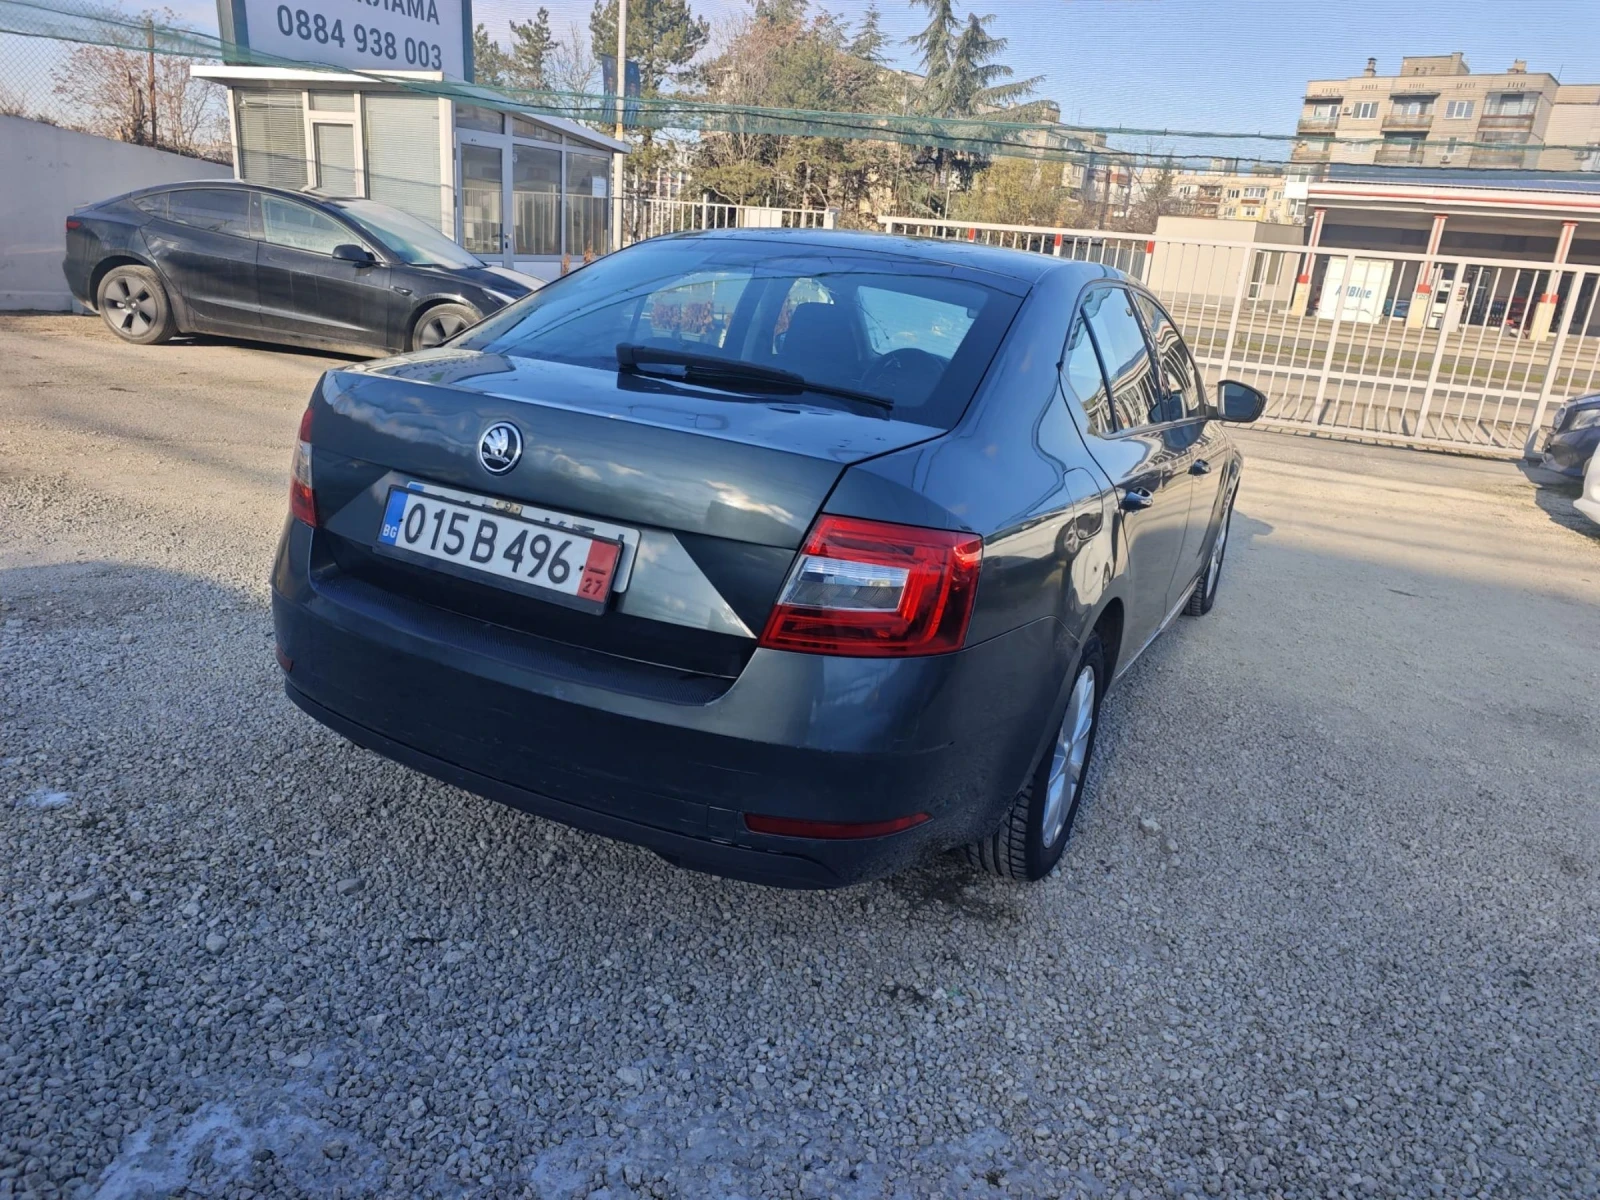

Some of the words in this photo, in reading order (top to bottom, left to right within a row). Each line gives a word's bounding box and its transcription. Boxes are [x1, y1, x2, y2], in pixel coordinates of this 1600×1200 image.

[277, 5, 345, 48] 0884
[354, 24, 397, 60] 938
[404, 37, 442, 70] 003
[382, 523, 398, 539] BG
[581, 577, 603, 596] 27
